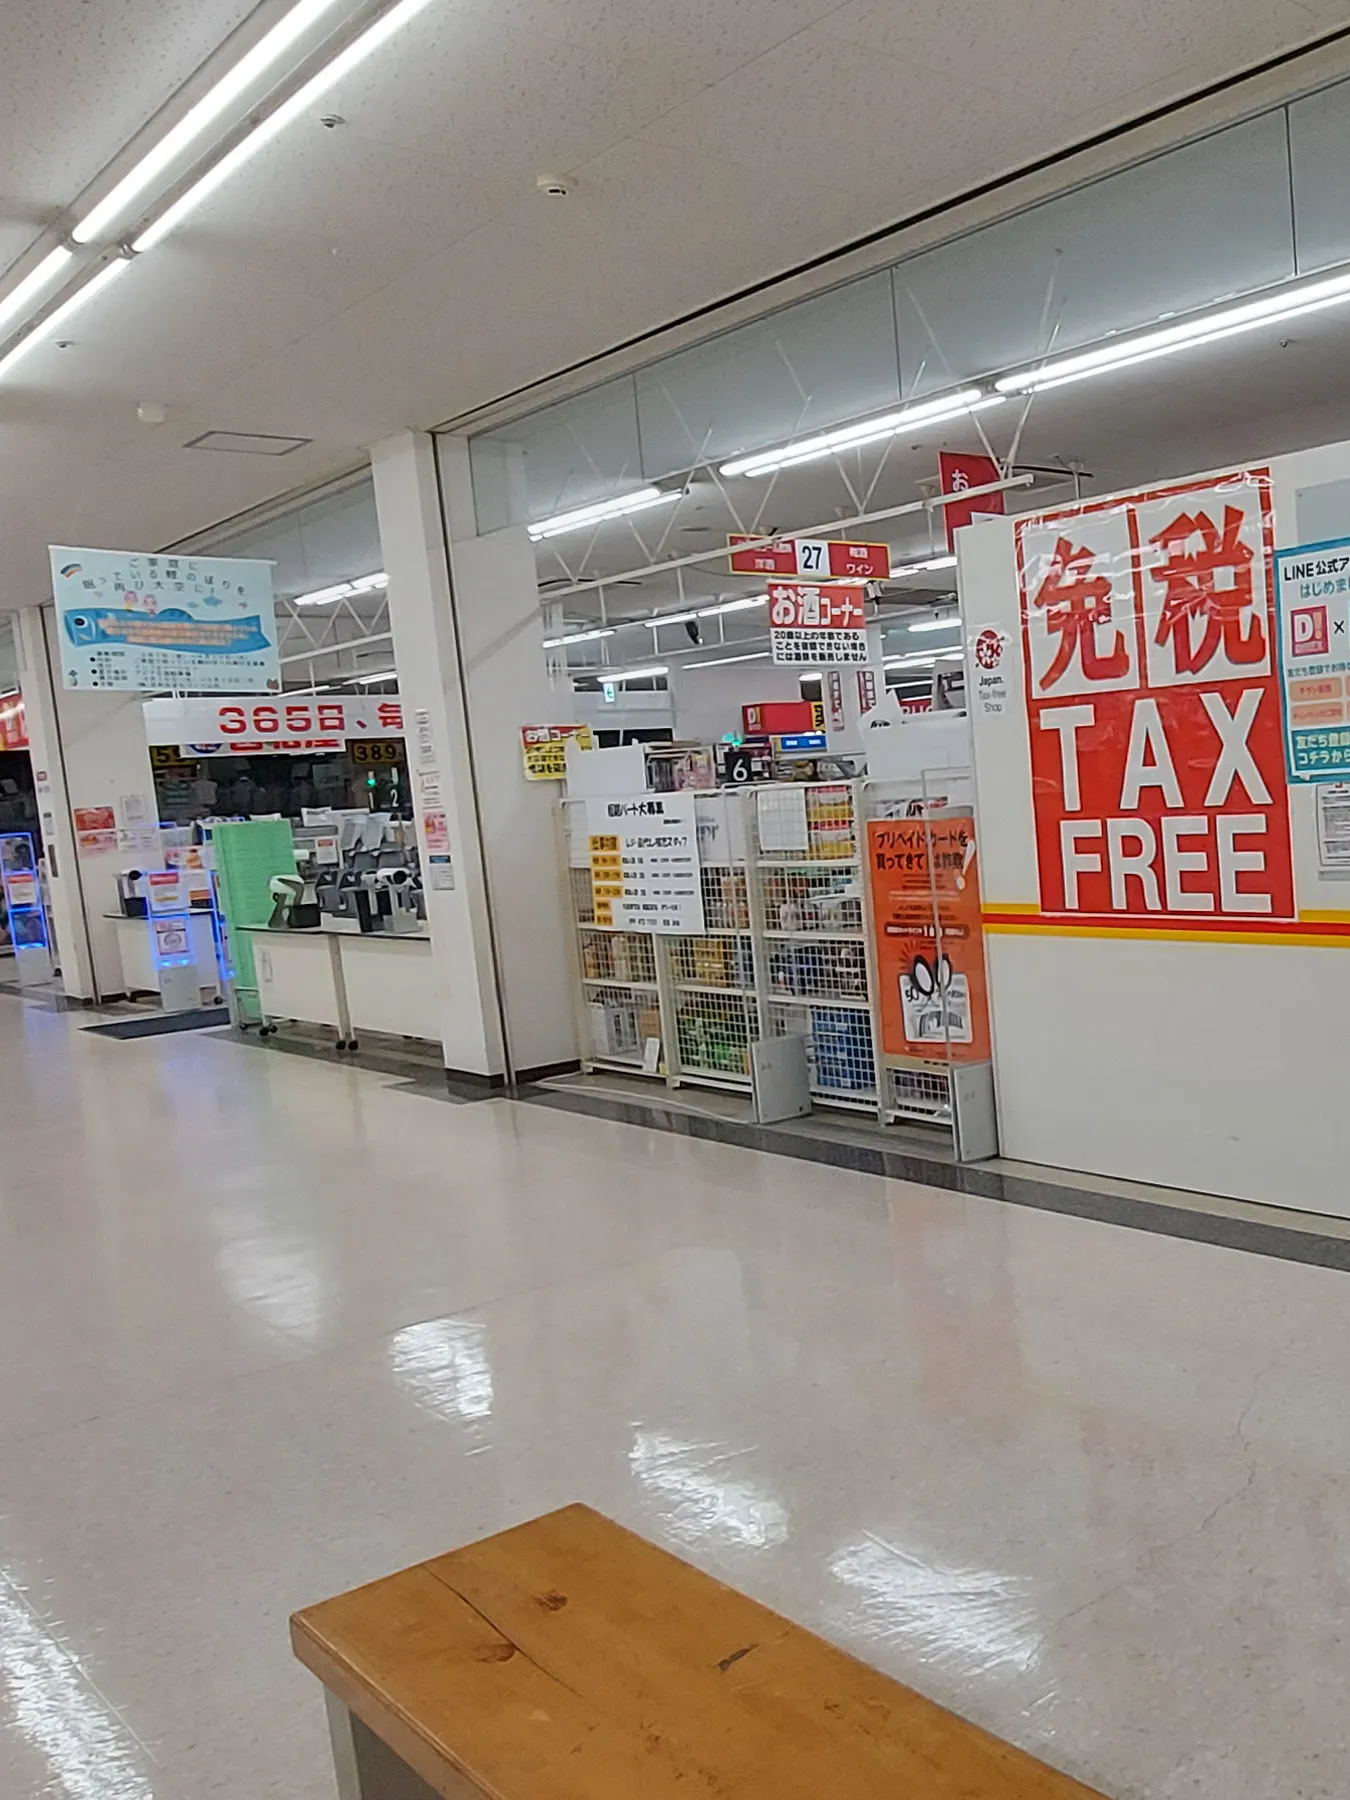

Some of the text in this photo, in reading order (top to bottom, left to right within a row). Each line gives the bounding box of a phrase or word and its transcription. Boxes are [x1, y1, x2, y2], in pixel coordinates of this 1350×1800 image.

[801, 545, 823, 570] 27
[845, 563, 874, 575] ワイン
[772, 586, 864, 628] お酒コーナー
[1034, 504, 1267, 691] 免税
[356, 745, 397, 762] 389
[1039, 687, 1275, 813] TAX
[732, 759, 748, 782] 6
[1058, 813, 1274, 914] FREE
